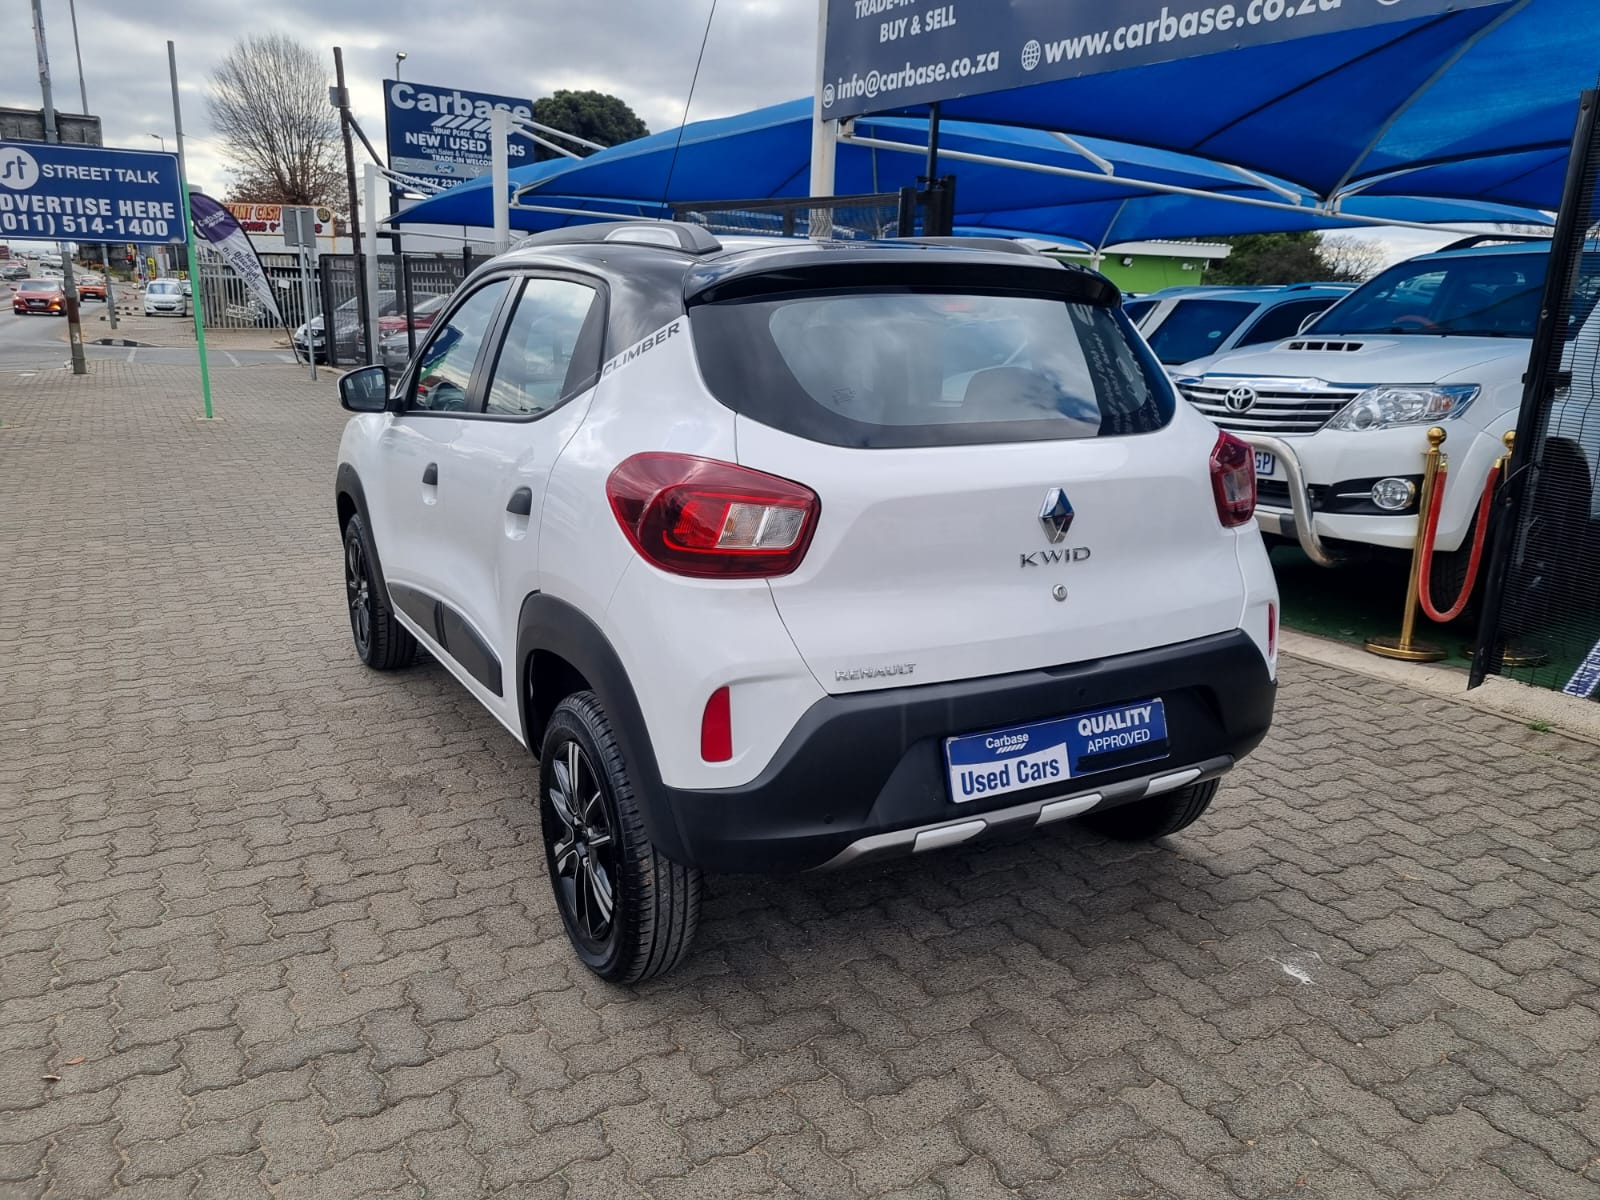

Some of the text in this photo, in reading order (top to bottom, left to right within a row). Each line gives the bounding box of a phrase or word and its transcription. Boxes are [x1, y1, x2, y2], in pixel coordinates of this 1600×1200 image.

[879, 5, 956, 43] BUY & SELL
[837, 51, 1000, 98] info@carbase.co.za
[405, 132, 440, 147] NEW
[449, 137, 487, 152] USED
[421, 147, 437, 155] Cash
[432, 155, 464, 164] TRADE-IN
[42, 164, 111, 181] STREET
[115, 169, 160, 184] TALK
[0, 193, 175, 219] DVERTISE HERE
[255, 206, 281, 221] CASH
[63, 216, 168, 236] 514-1400
[602, 322, 680, 377] CLIMBER
[1020, 546, 1091, 568] KWID
[835, 663, 916, 681] RENAULT
[1078, 705, 1151, 737] QUALITY
[985, 733, 1029, 749] Carbase
[1087, 728, 1150, 754] APPROVED
[960, 758, 1060, 795] Used Cars
